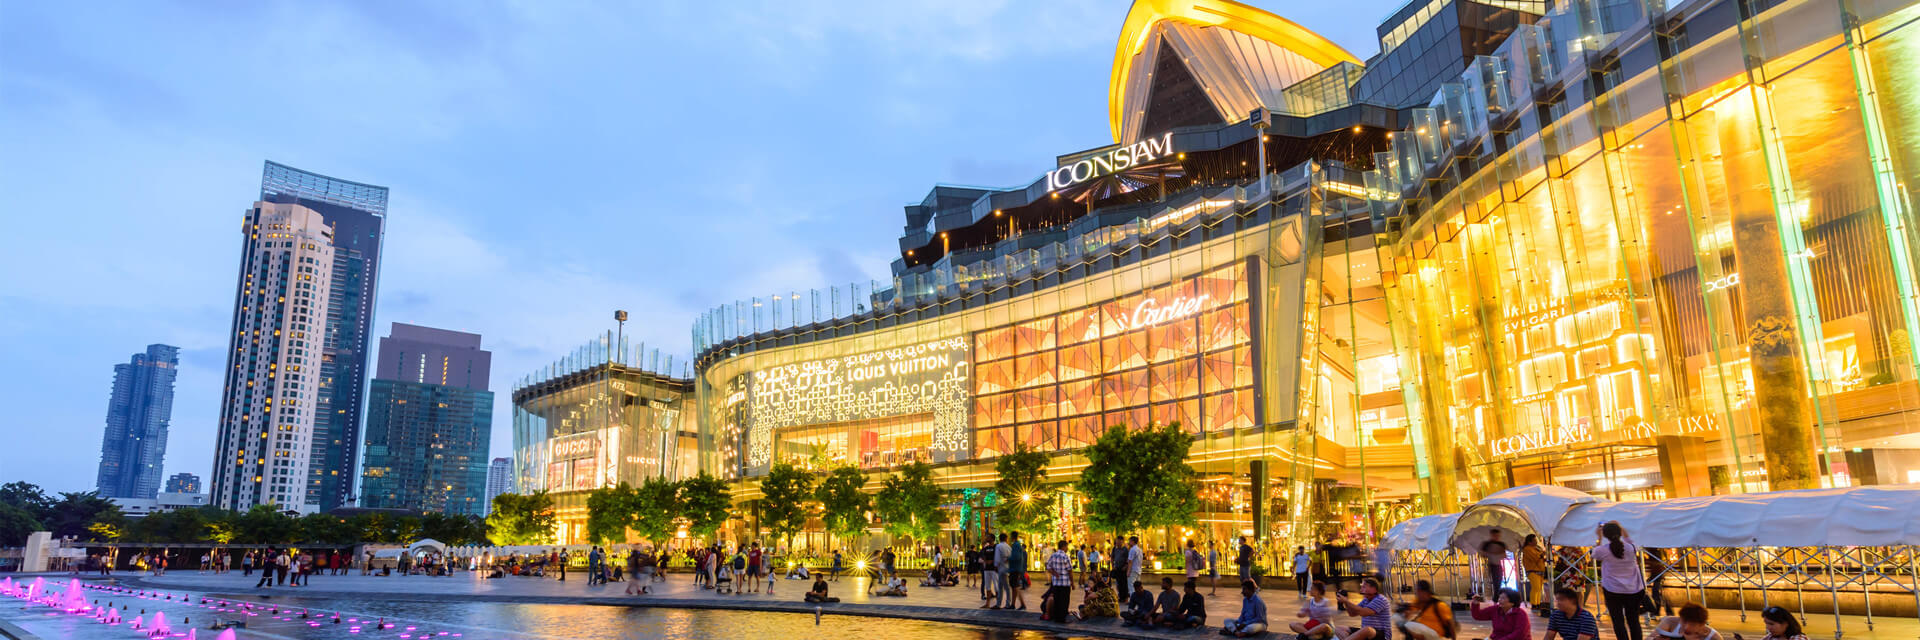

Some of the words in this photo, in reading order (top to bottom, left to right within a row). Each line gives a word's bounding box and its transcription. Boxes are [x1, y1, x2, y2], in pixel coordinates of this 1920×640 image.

[1046, 132, 1174, 192] ICONSIAM
[1130, 293, 1210, 328] Cartier
[847, 364, 886, 382] LOUIS
[889, 353, 949, 376] VUITTON
[555, 439, 593, 456] GUCCI
[1491, 421, 1592, 456] ICONLUXE
[626, 455, 657, 465] GUCCI
